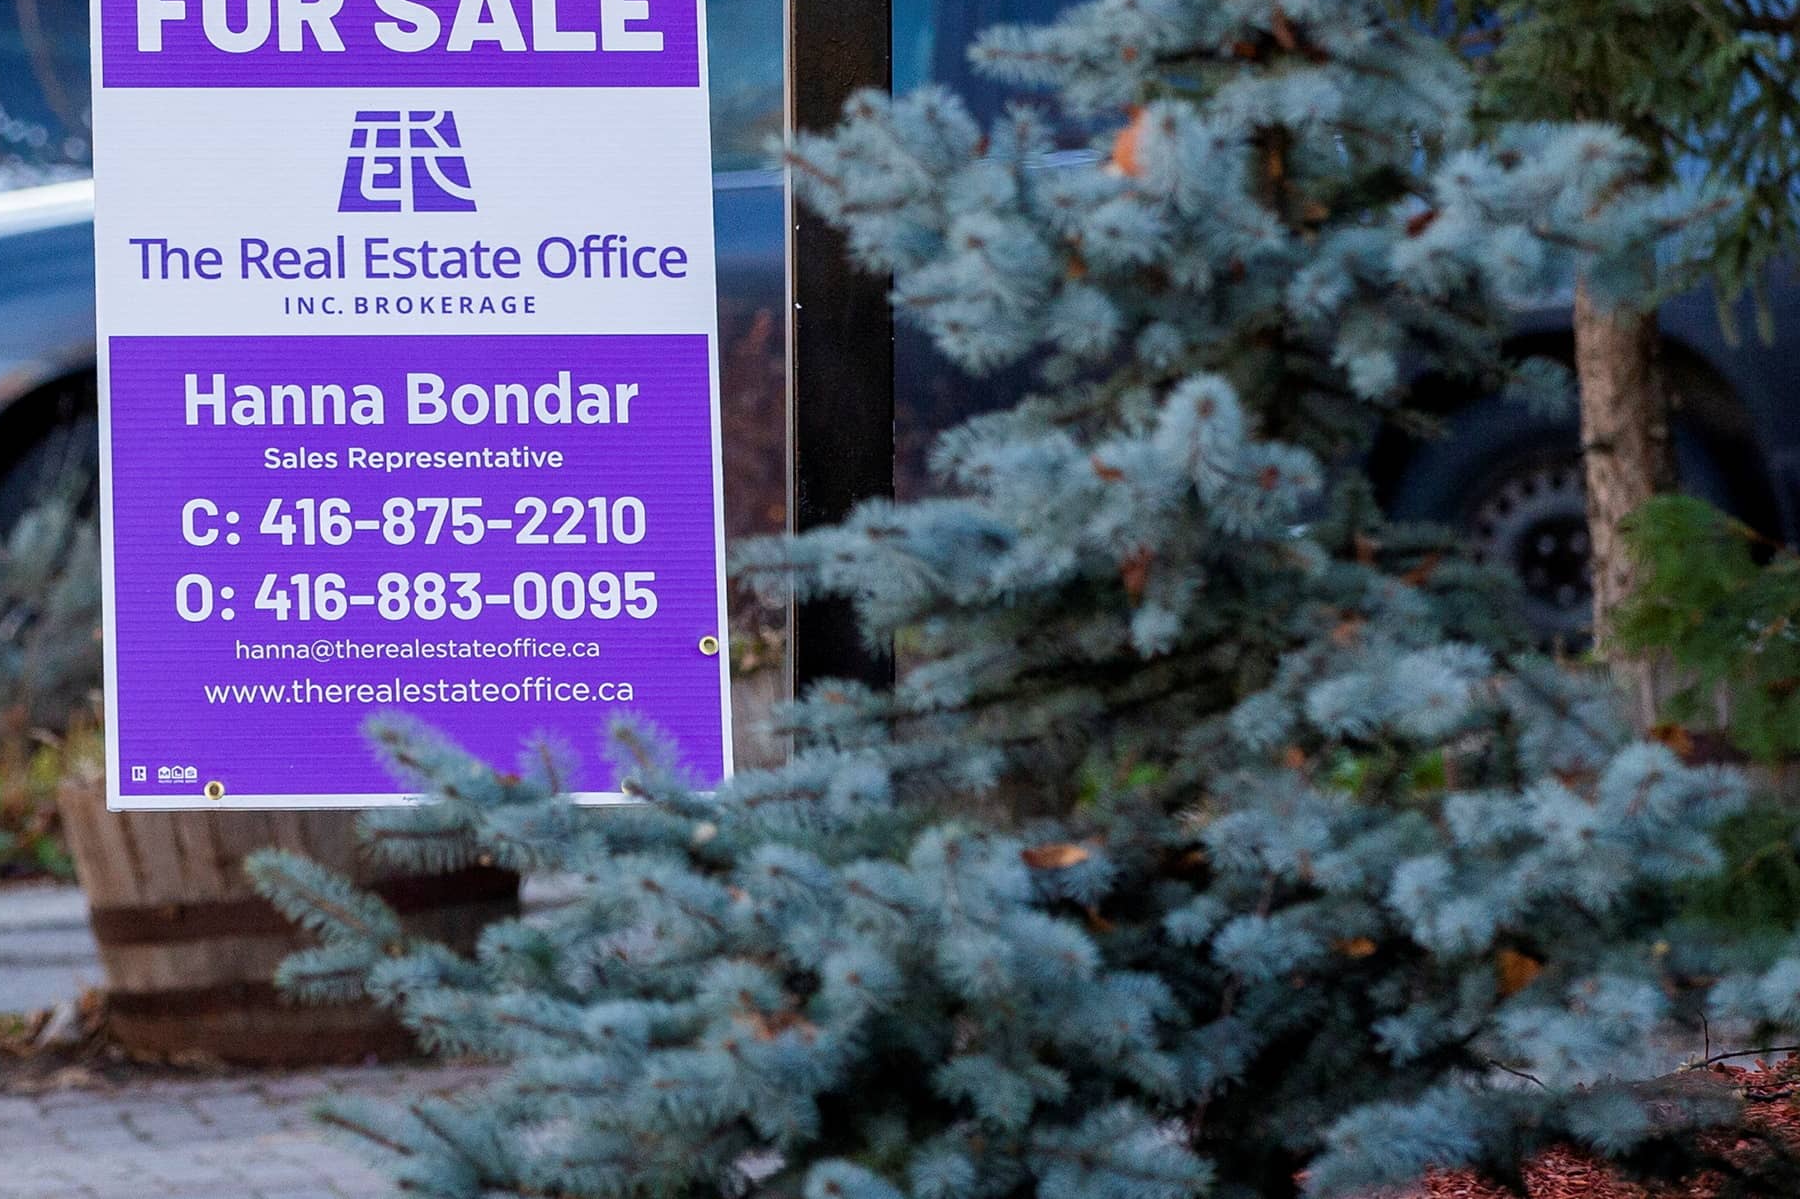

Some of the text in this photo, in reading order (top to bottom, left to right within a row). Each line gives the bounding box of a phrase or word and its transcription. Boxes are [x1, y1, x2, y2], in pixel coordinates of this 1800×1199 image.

[129, 234, 688, 280] The Real Estate Office
[285, 295, 536, 315] INC. BROKERAGE
[184, 370, 639, 426] Hanna Bondar
[264, 445, 564, 473] Sales Representative
[181, 496, 646, 547] C: 416-875-2210
[175, 571, 658, 622] O: 416-883-0095
[235, 637, 600, 663] hanna@therealestateoffice.ca
[204, 676, 634, 704] www.therealestateoffice.ca
